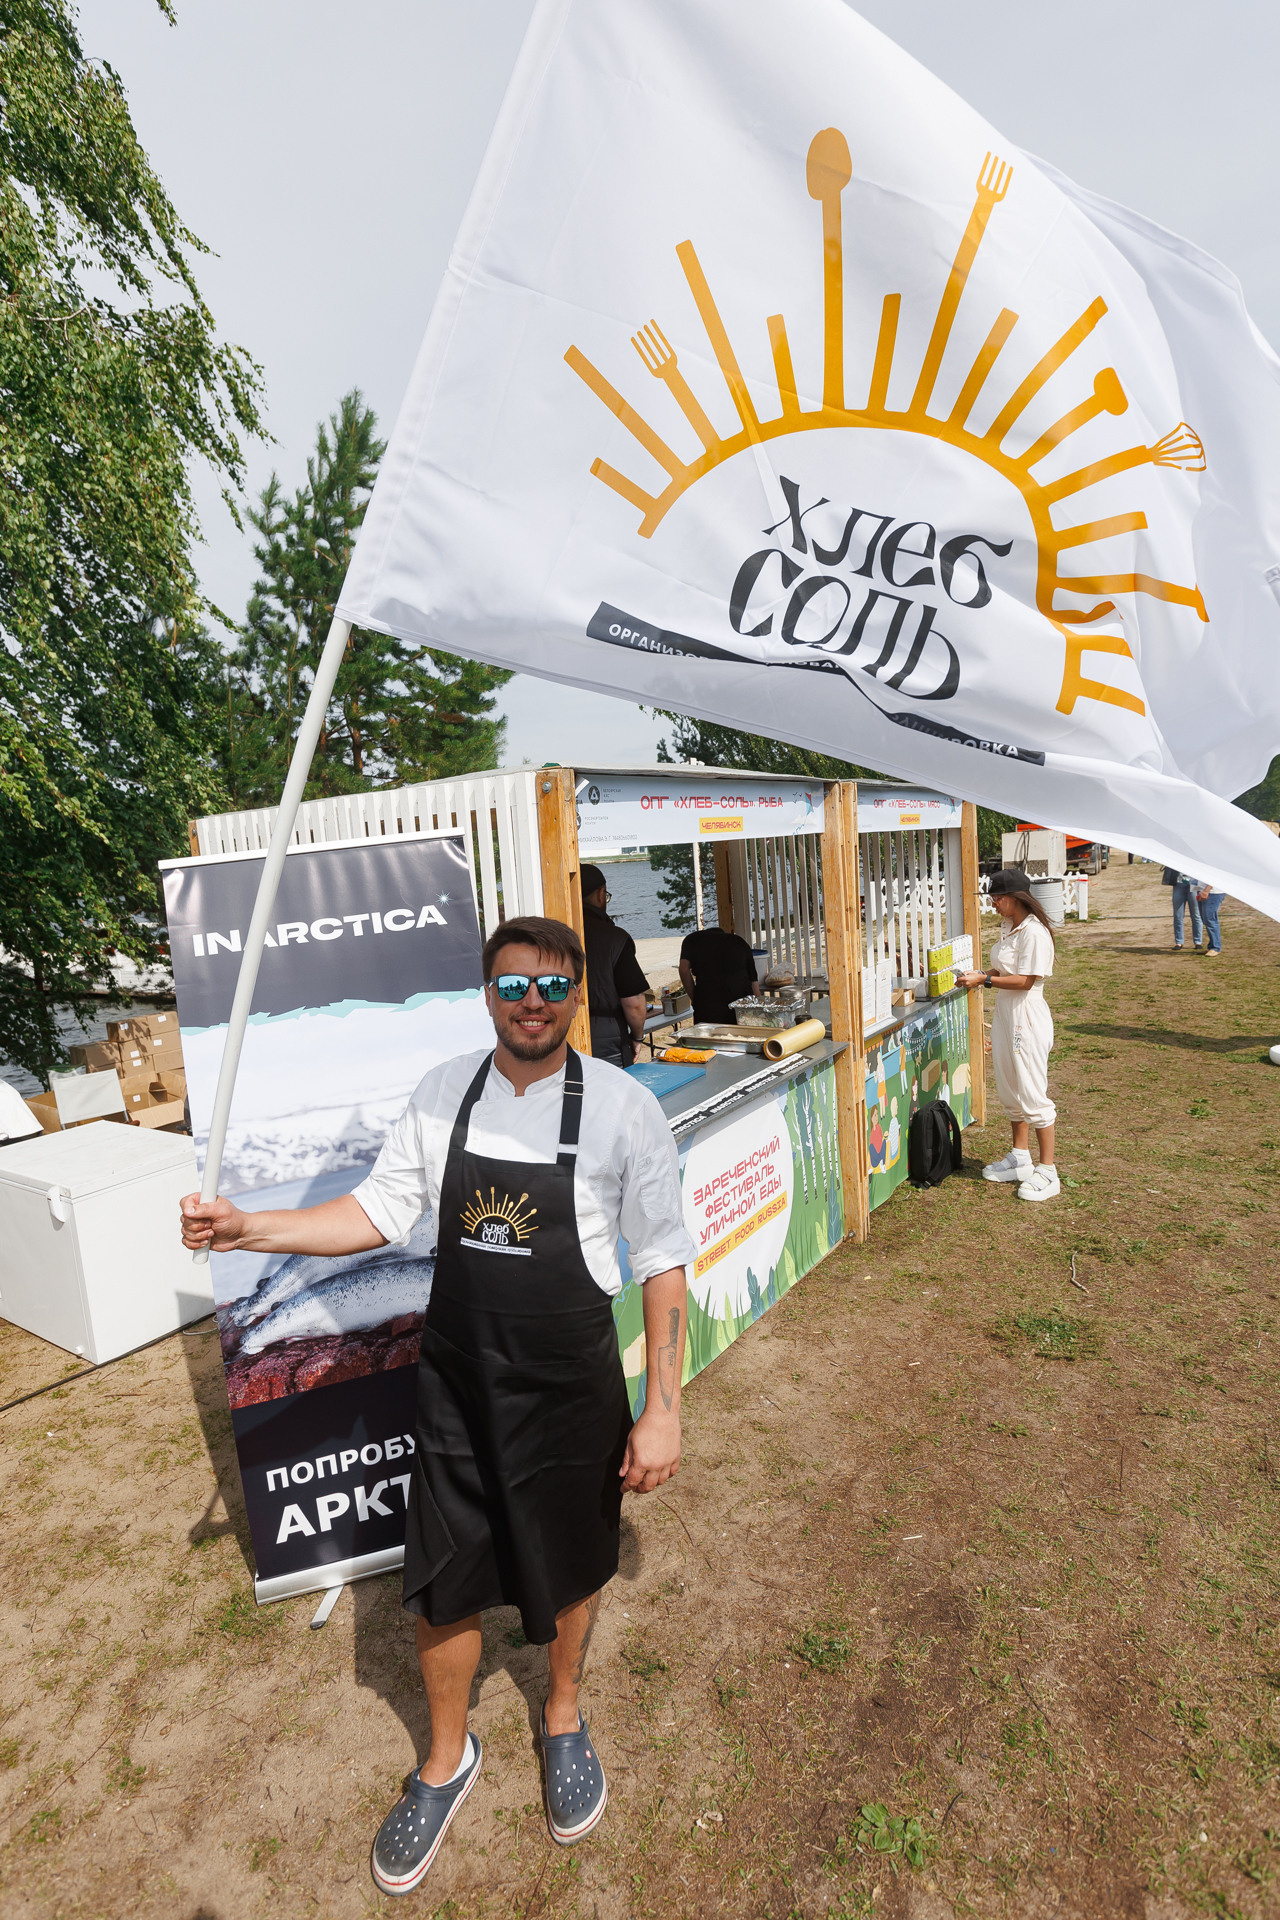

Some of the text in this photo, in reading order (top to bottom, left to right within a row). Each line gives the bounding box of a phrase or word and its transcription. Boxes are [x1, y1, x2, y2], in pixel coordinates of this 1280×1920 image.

[640, 795, 669, 810] ОПГ
[758, 796, 783, 808] РЫБА
[701, 820, 742, 830] ЧЕЛЯБИНСК
[694, 1135, 780, 1206] ЗАРЕЧЕНСКИЙ
[705, 1163, 774, 1218] ФЕСТИВАЛЬ
[697, 1197, 786, 1272] STREET FOOD RUSSIA
[700, 1174, 782, 1246] УЛИЧНОЙ ЕДЫ
